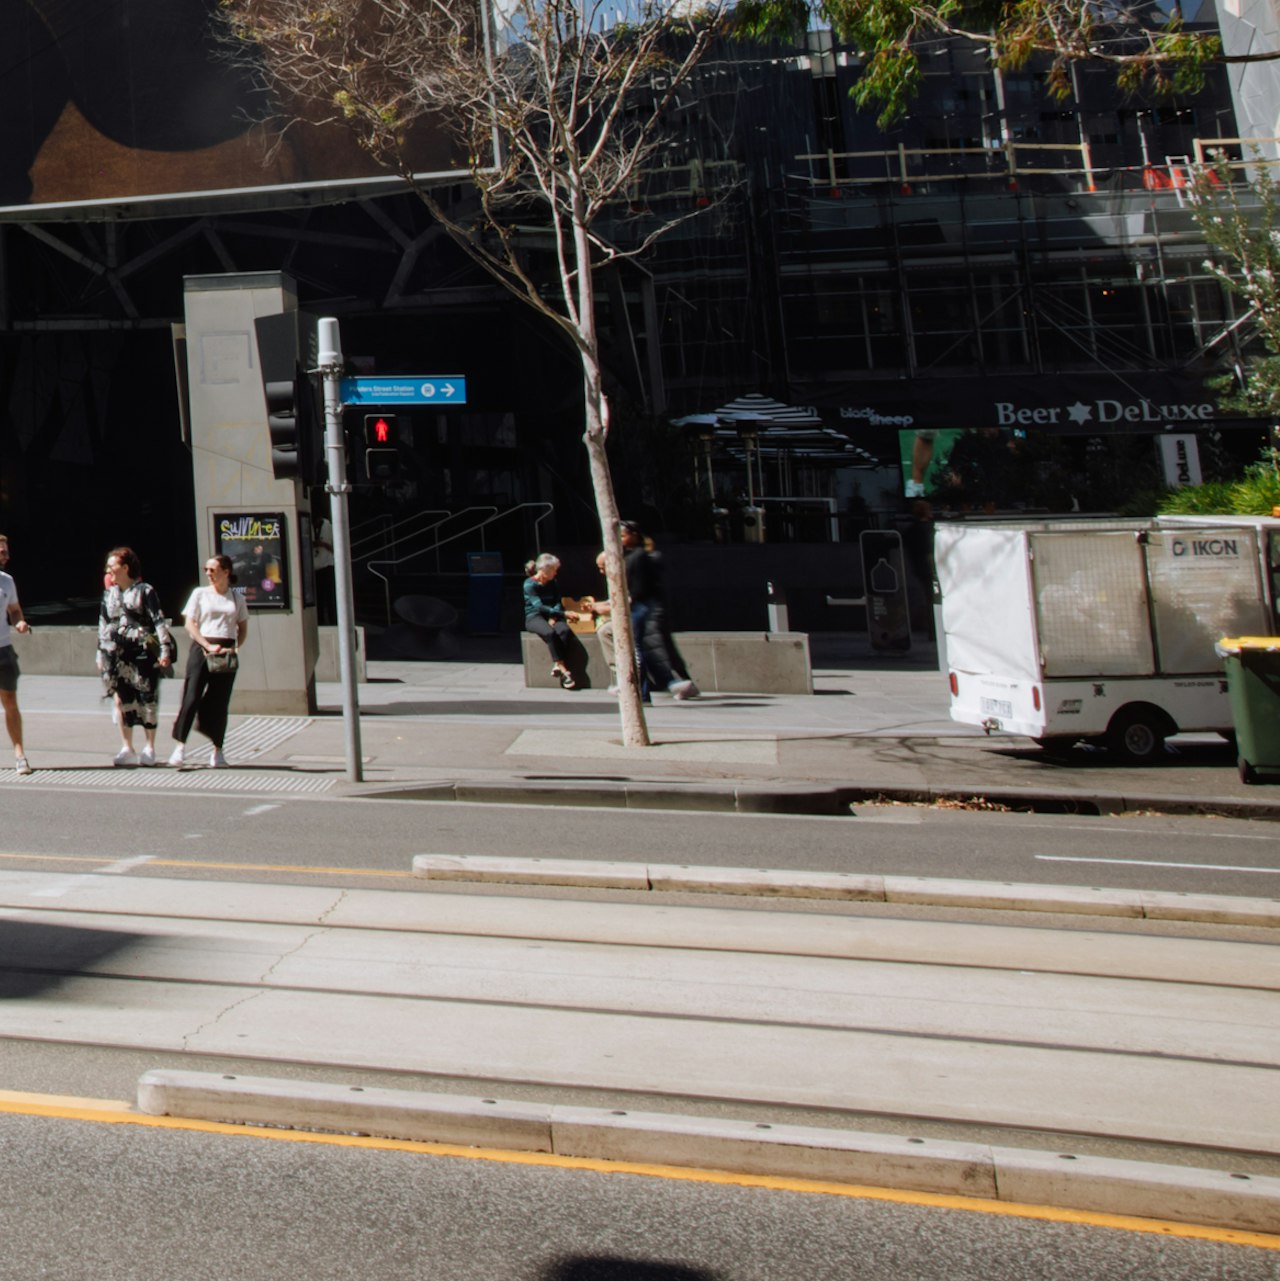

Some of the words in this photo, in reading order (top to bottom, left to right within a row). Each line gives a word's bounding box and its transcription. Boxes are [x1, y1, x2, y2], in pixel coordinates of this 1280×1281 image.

[393, 384, 415, 392] Station
[995, 402, 1061, 425] Beer
[1096, 399, 1214, 423] DeLuxe
[1192, 540, 1239, 556] IKON
